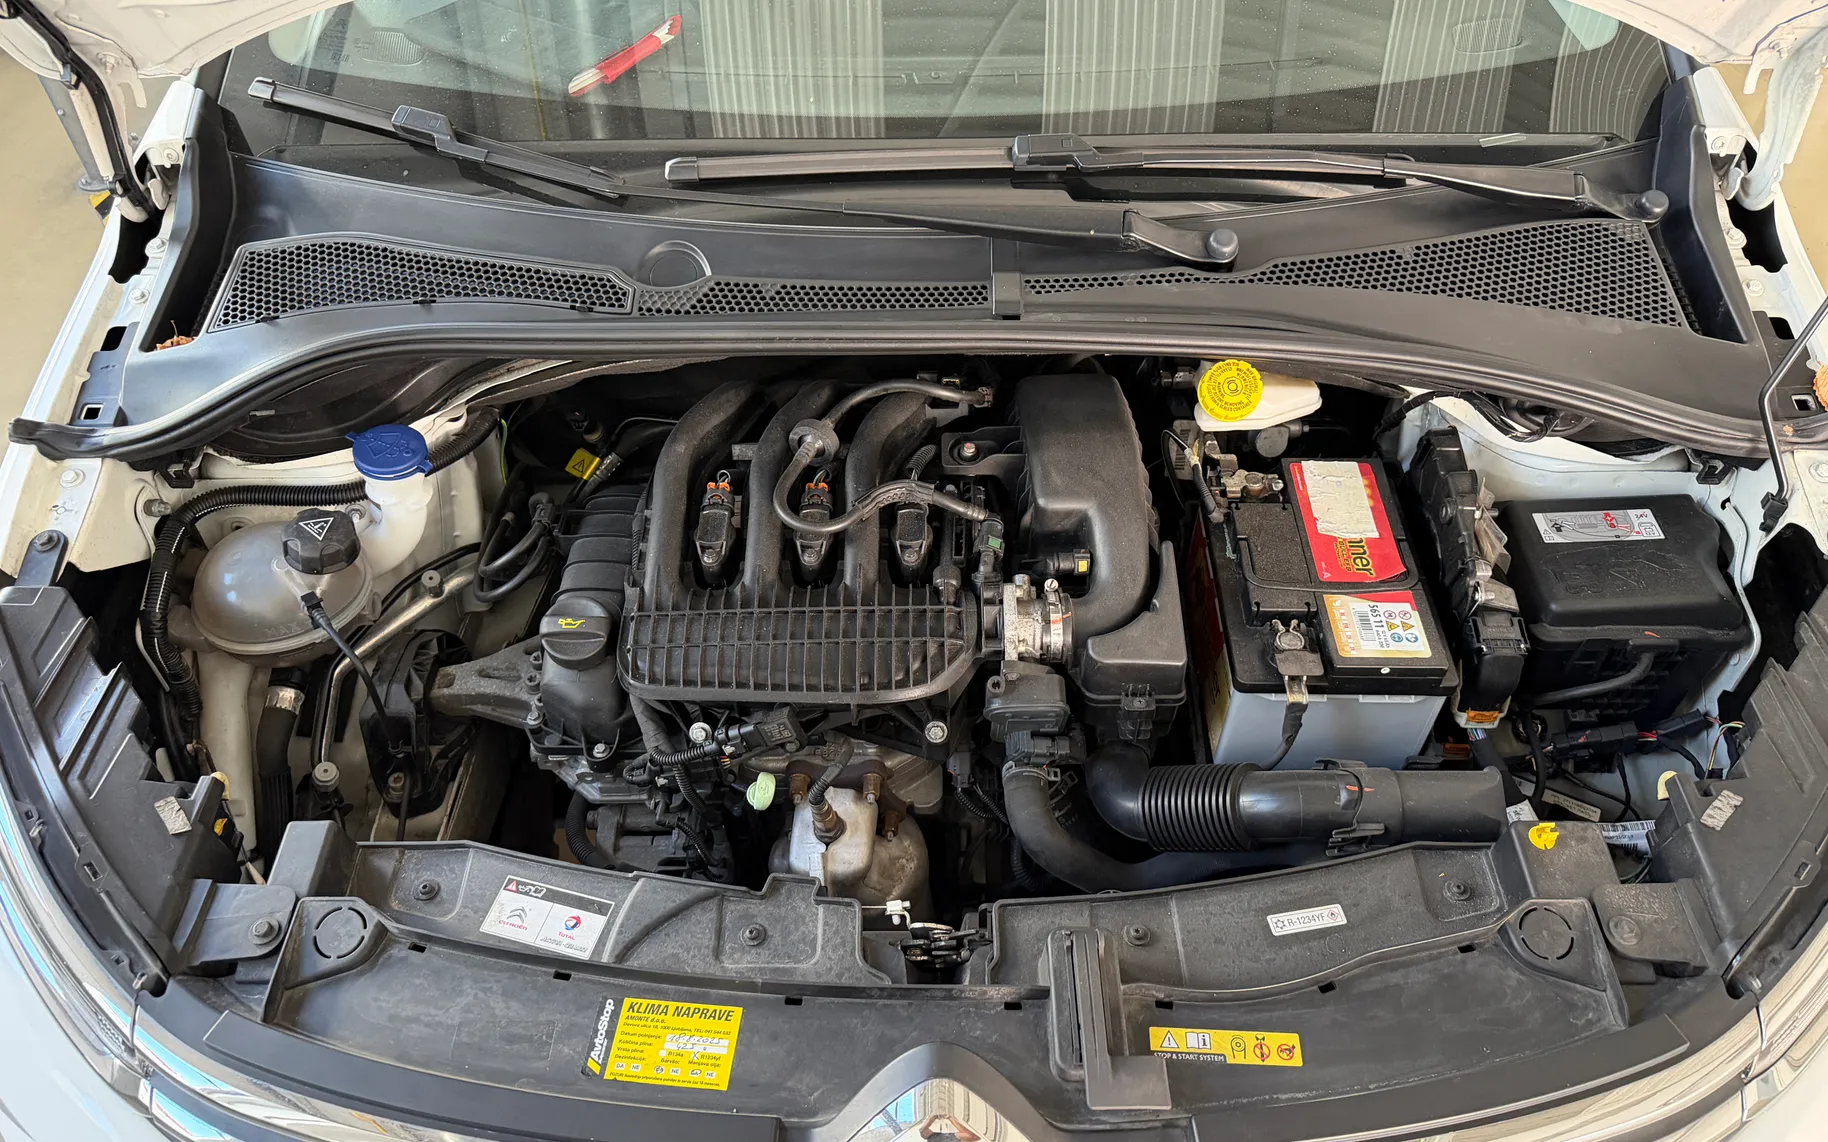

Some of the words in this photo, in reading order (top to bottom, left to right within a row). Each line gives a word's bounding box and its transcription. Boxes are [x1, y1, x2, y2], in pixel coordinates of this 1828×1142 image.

[1347, 538, 1374, 576] nner
[1368, 604, 1381, 617] 565
[1373, 620, 1384, 628] 11
[1287, 912, 1325, 927] R-1234YF
[627, 1001, 669, 1015] KLIMA
[672, 1005, 734, 1021] NAPRAVE
[590, 999, 615, 1061] AvtoStop
